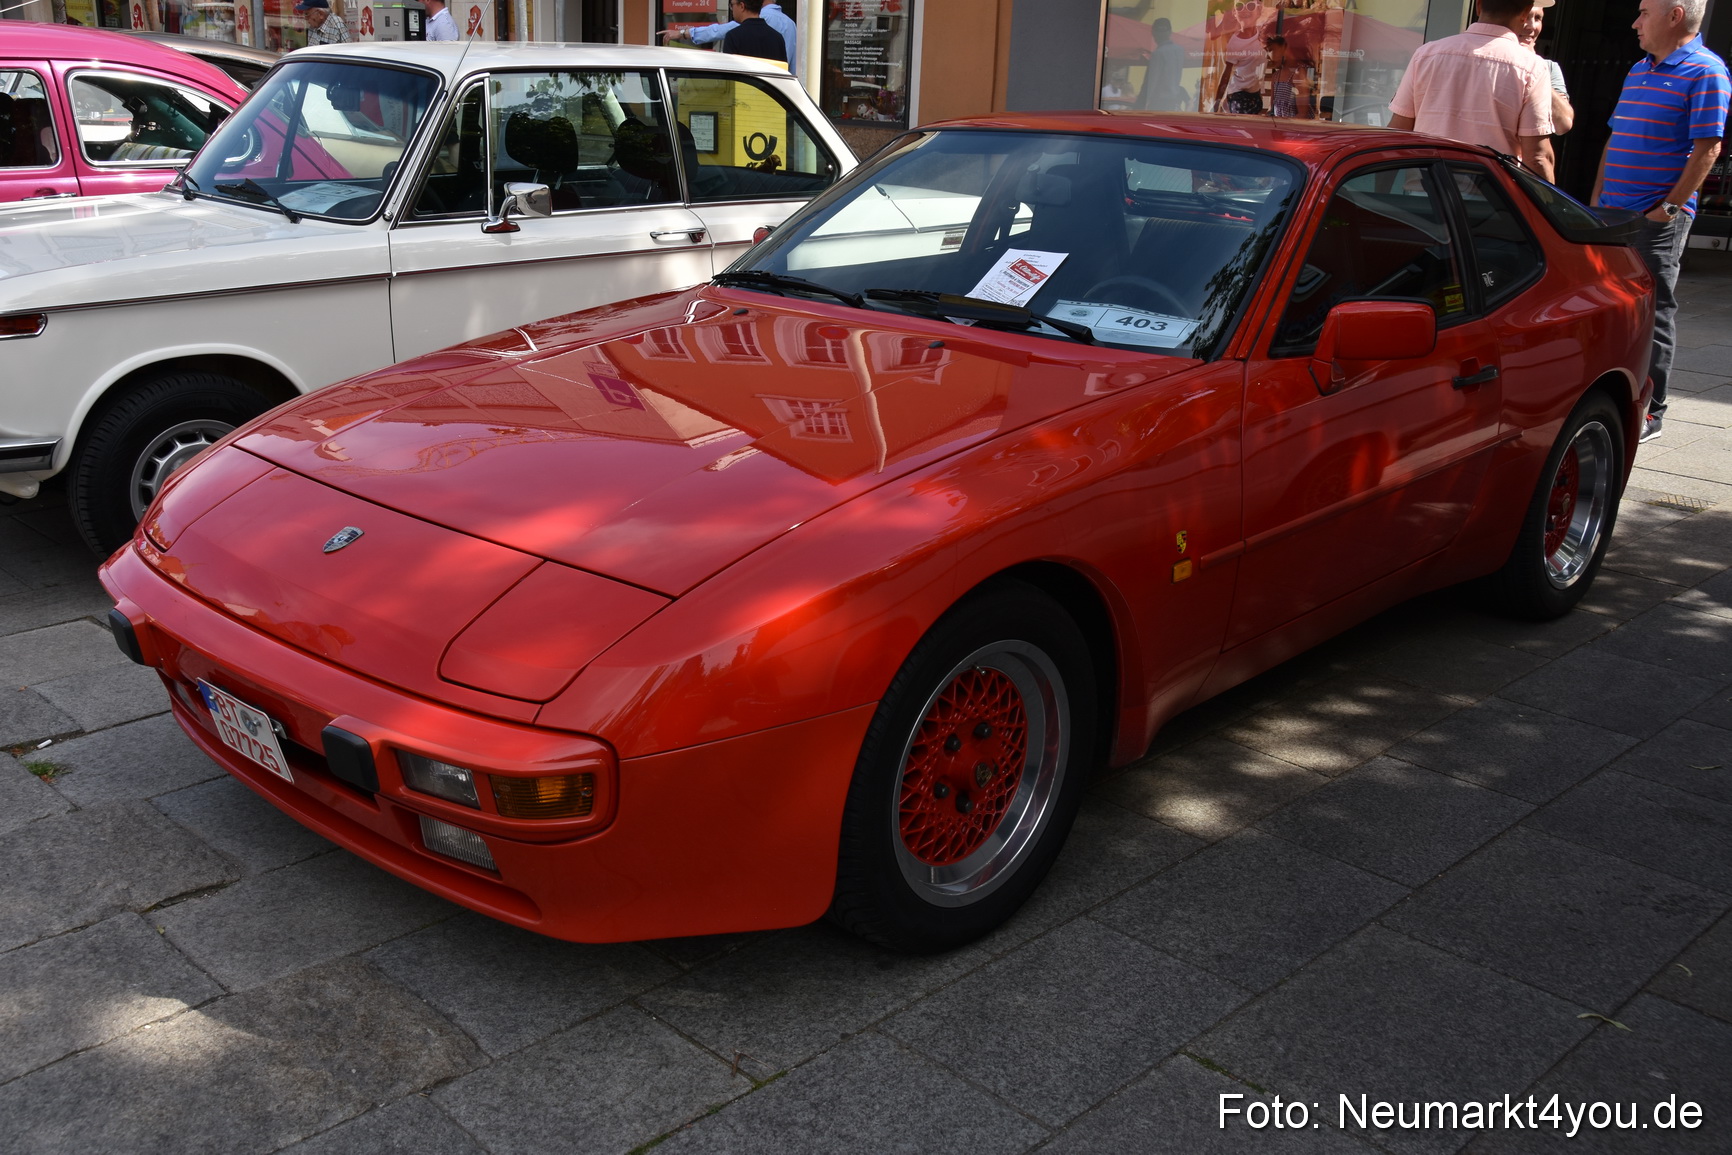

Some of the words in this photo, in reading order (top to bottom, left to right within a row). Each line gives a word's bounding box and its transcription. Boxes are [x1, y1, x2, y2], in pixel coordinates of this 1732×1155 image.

[1115, 316, 1169, 332] 403
[213, 691, 241, 729] BT
[220, 720, 282, 774] 07725
